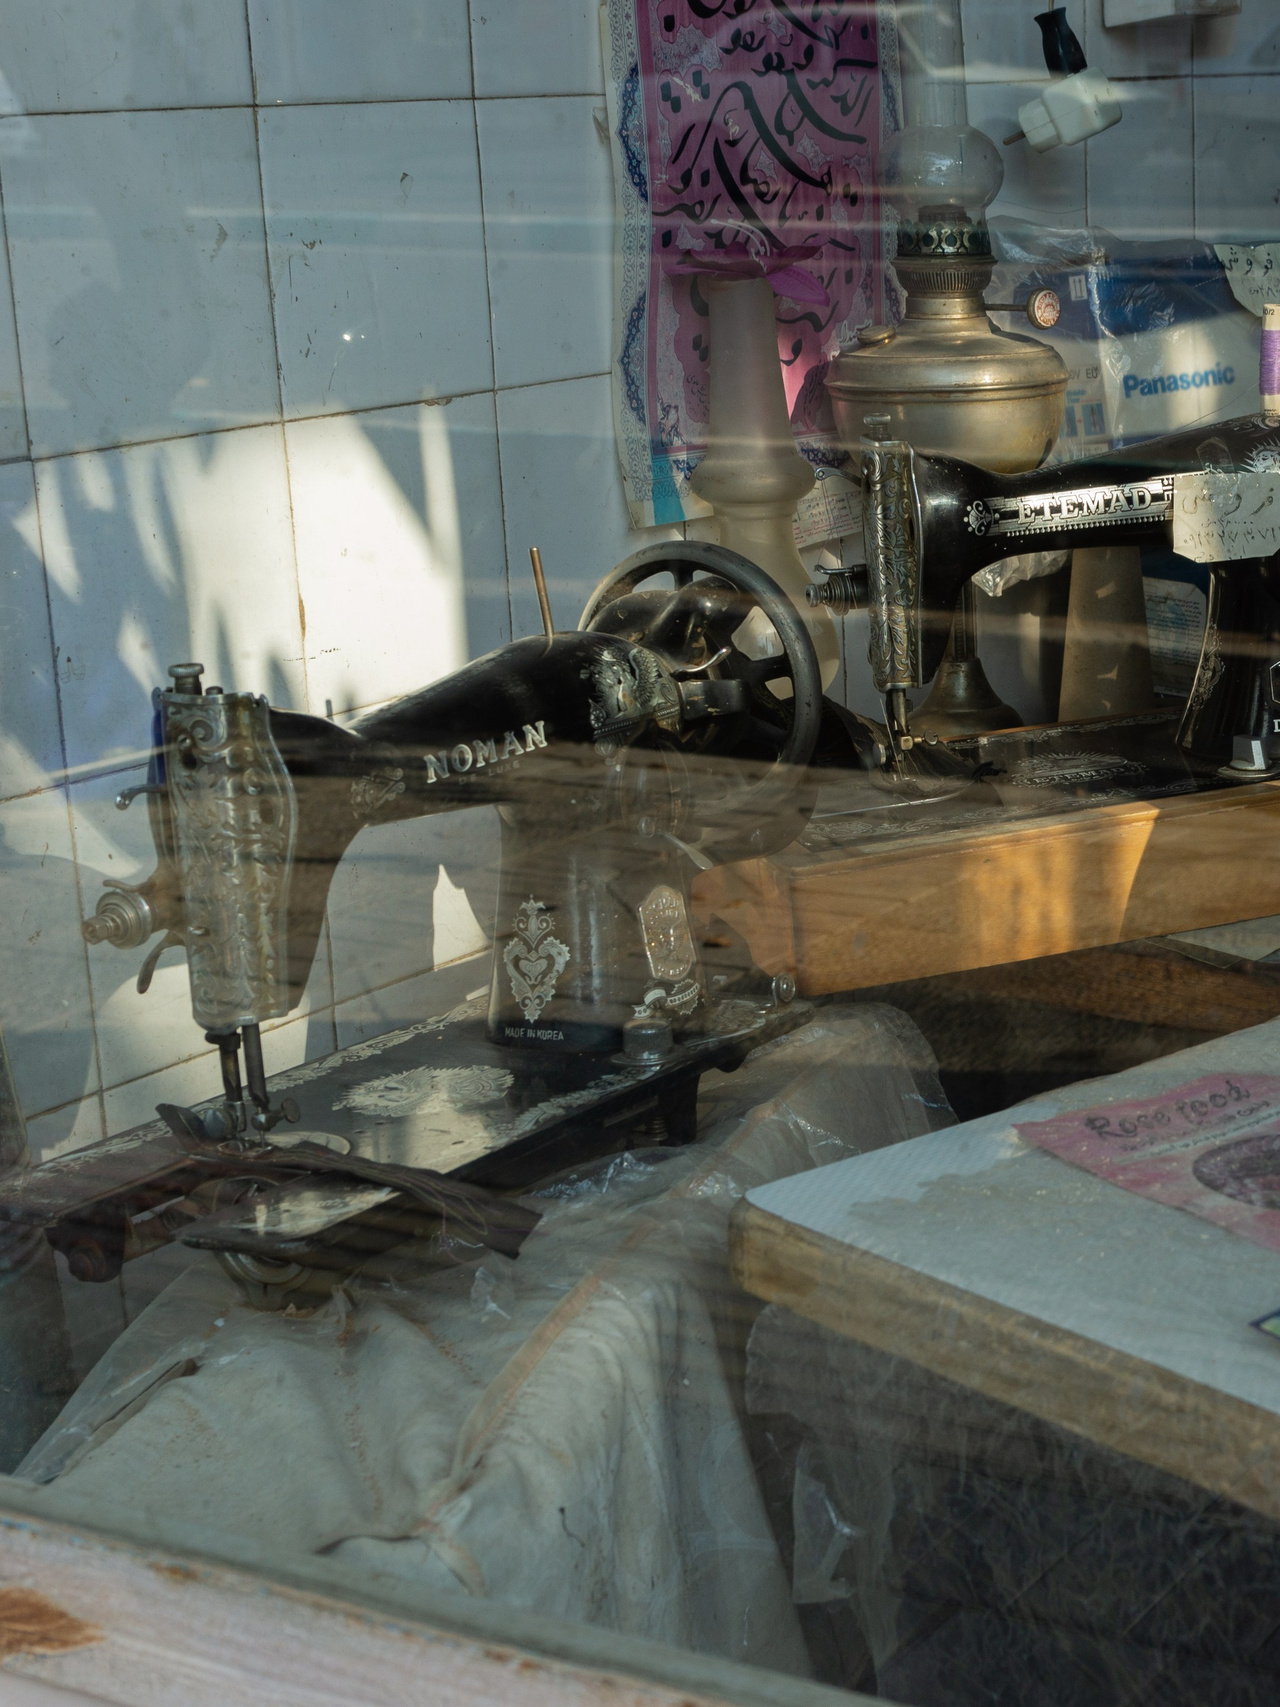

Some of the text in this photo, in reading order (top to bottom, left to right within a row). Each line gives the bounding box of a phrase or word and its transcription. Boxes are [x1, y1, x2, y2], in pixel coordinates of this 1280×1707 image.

[1123, 363, 1236, 399] Panasonic
[1017, 487, 1153, 524] ETEMAD
[423, 720, 549, 784] NOMAN
[505, 1028, 564, 1041] MADE IN KOREA
